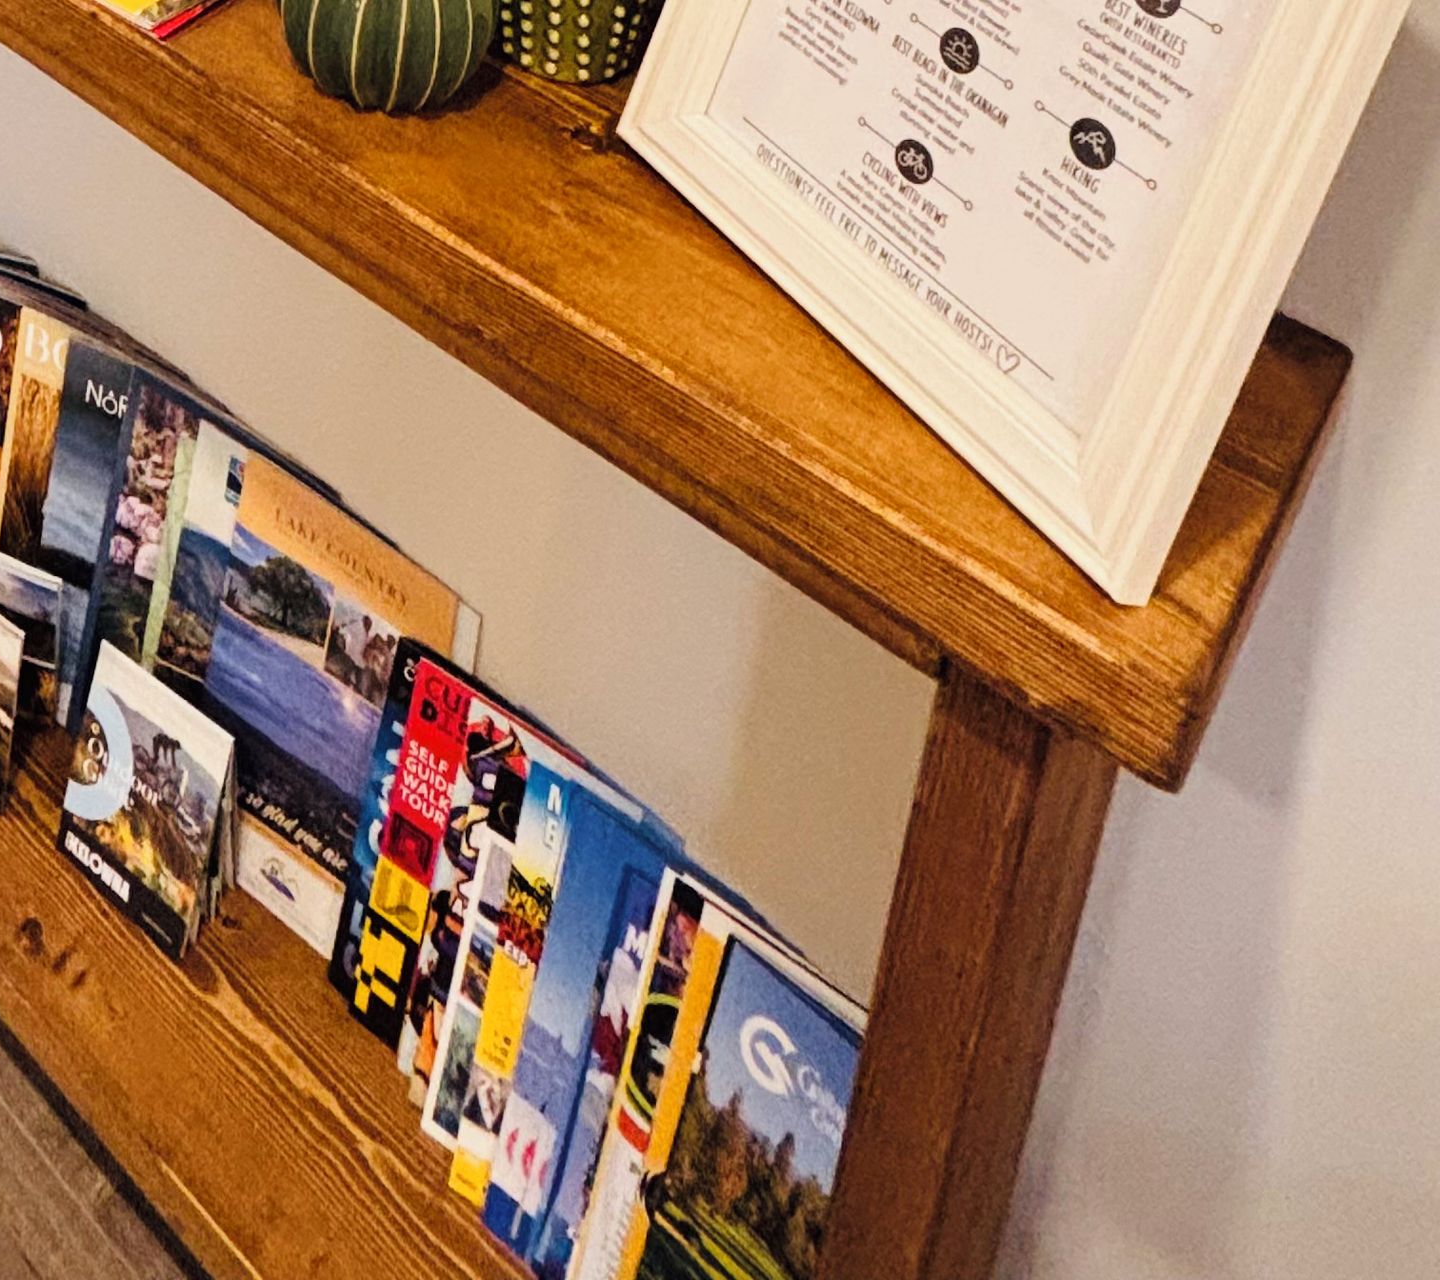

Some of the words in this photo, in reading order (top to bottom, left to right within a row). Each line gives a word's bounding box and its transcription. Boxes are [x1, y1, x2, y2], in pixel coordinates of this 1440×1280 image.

[843, 0, 881, 34] KELOWNA
[1131, 10, 1190, 56] WINERIES
[891, 33, 913, 57] BEST
[911, 48, 939, 76] BEACH
[937, 66, 950, 84] IN
[948, 74, 966, 96] THE
[963, 86, 1010, 128] OKANAGAN
[860, 150, 897, 188] CYCLING
[896, 178, 921, 207] WITH
[919, 197, 949, 229] VIEWS
[1058, 154, 1102, 195] HIKING
[755, 140, 814, 200] QUESTIONS?
[812, 190, 838, 221] FEEL
[837, 212, 862, 242] FREE
[863, 233, 878, 256] TO
[876, 245, 923, 294] MESSAGE
[923, 285, 952, 319] YOUR
[951, 309, 994, 355] HOSTS!
[409, 740, 449, 773] SELF
[399, 784, 447, 829] TOUR
